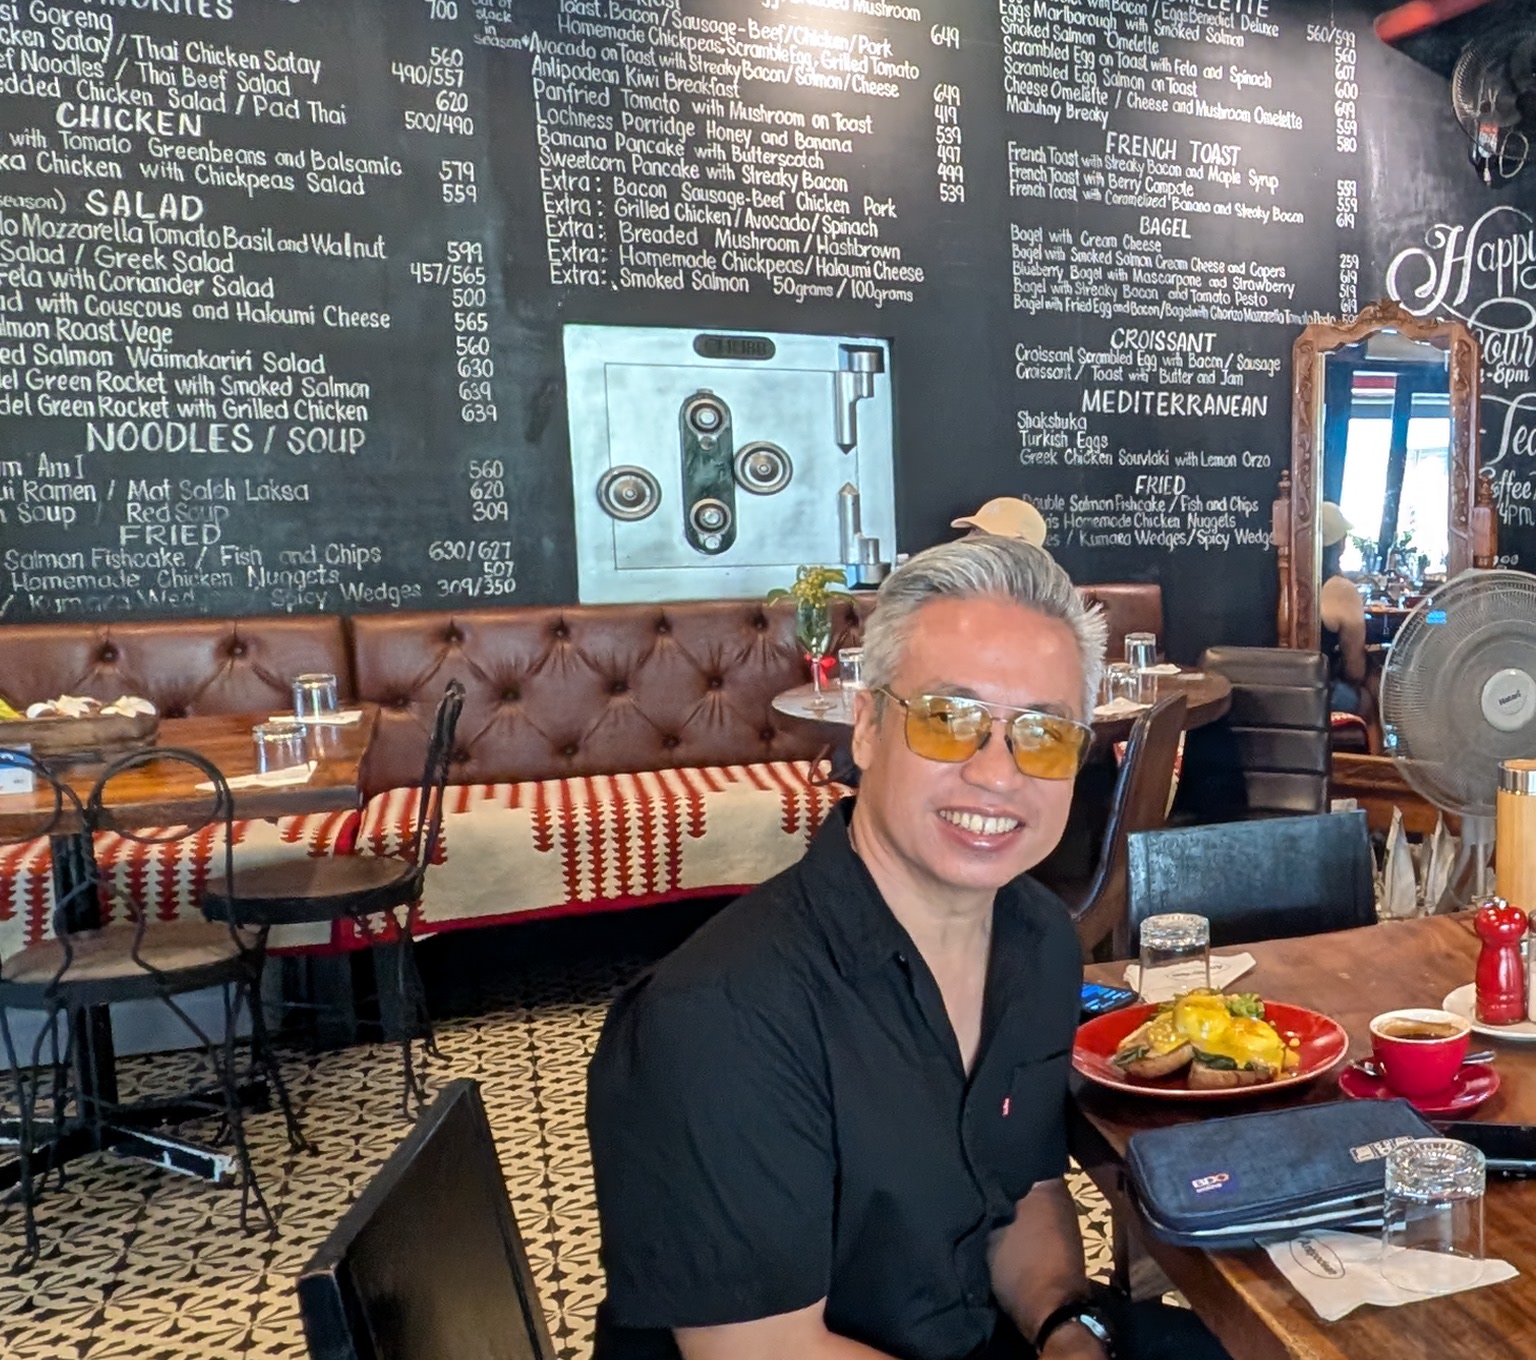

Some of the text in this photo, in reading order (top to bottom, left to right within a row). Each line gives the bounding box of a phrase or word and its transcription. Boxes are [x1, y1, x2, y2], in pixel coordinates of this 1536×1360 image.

[29, 1, 464, 67] Goreng 560
[132, 34, 179, 61] Thai
[186, 41, 261, 70] Chicken
[264, 47, 321, 84] Satay
[20, 49, 468, 111] Noodles Thai Beef Salad 620
[625, 65, 660, 90] Kiwi
[664, 71, 741, 99] Breakfast
[934, 105, 958, 123] 419
[56, 102, 202, 136] CHICKEN
[533, 78, 962, 144] Panfried Tomato with Mushroom on Toast 539
[1006, 95, 1061, 123] Mabuhay
[536, 101, 961, 163] Lochness Porridge Honey and Banana 497
[58, 131, 475, 182] Tomato Greenbeans Balsamic 579
[537, 125, 964, 183] Banana Pancake with Butterscotch 499
[1106, 132, 1242, 167] FRENCH TOAST
[36, 154, 477, 204] Chicken with Chickpeas Salad 559
[1208, 165, 1242, 186] Maple
[85, 188, 205, 222] SALAD
[1123, 231, 1162, 252] Cheese
[1139, 216, 1192, 238] BAGEL
[94, 246, 486, 286] Greek Salad 457/565
[620, 266, 685, 290] Smoked
[691, 271, 750, 293] Salmon
[99, 271, 486, 308] Coriander Salad 500
[36, 292, 488, 333] with Couscous and Haloumi Cheese 565
[55, 318, 173, 352] Roast Vege
[1110, 328, 1217, 354] CROISSANT
[33, 344, 114, 368] Salmon
[263, 352, 326, 375] Salad
[1081, 389, 1268, 417] MEDITERRANEAN
[86, 422, 366, 455] NOODLES SOUP
[1019, 431, 1109, 454] Turkish Eggs
[1020, 448, 1271, 468] Greek Chicken Souvlaki Lemon Orzo
[1135, 474, 1186, 496] FRIED
[119, 524, 222, 546] FRIED
[1191, 1173, 1230, 1189] BDO
